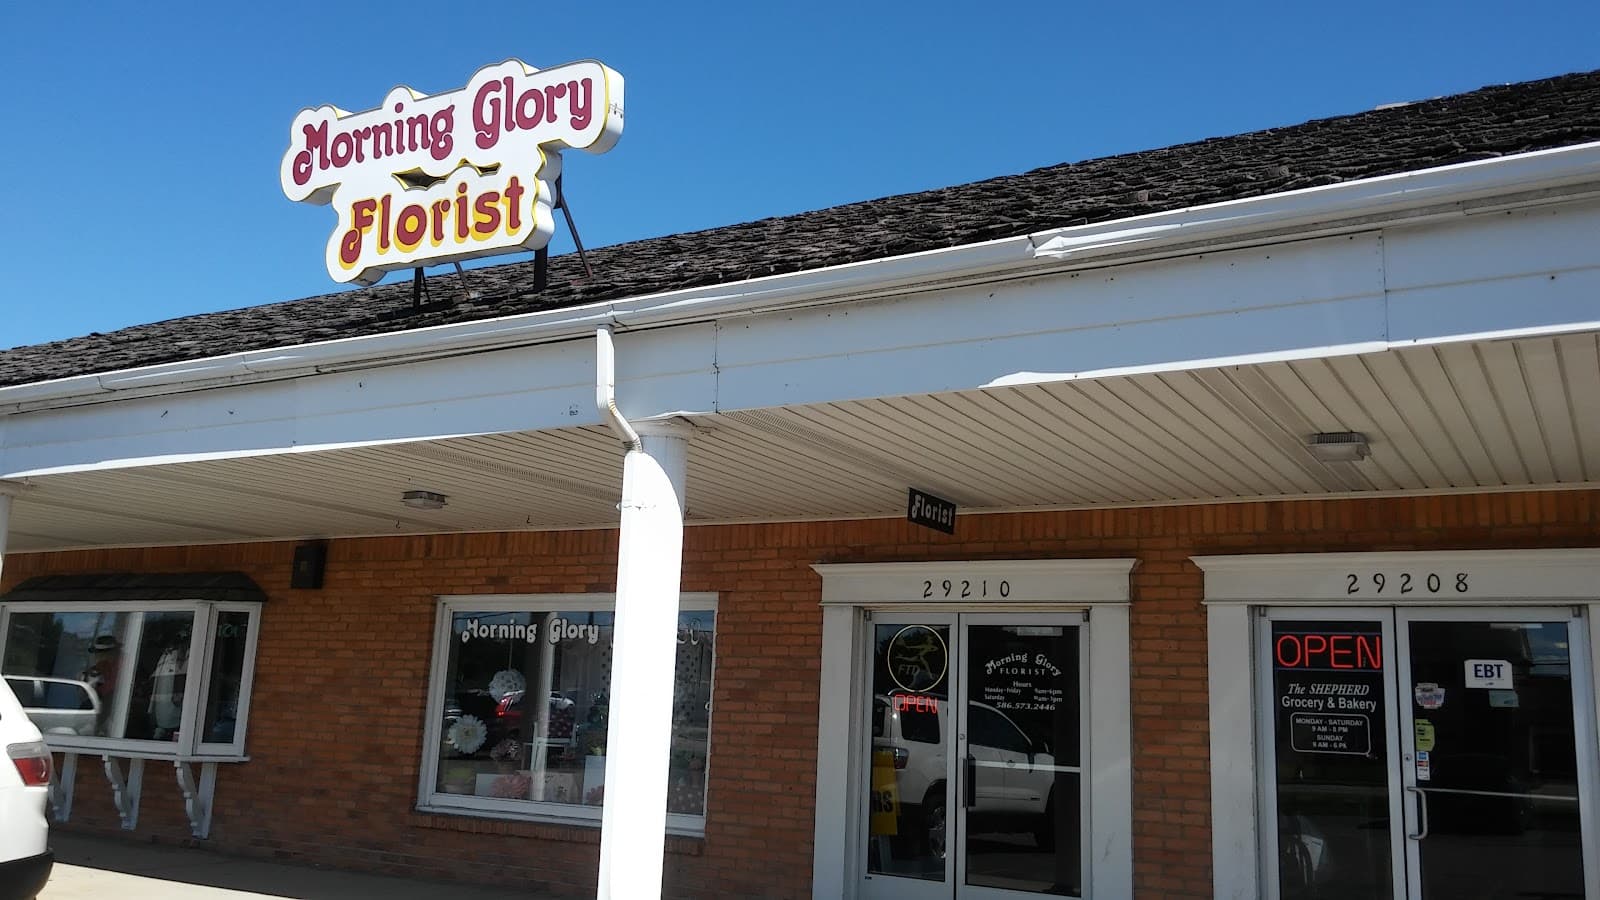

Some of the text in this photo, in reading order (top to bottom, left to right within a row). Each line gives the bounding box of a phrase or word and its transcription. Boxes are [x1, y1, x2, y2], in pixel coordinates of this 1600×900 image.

[293, 76, 592, 185] Morning Glory
[339, 176, 525, 268] Florist
[911, 494, 953, 526] Florist
[923, 580, 1010, 598] 29210
[1347, 573, 1468, 594] 29208
[461, 618, 599, 644] Morning Glory
[1277, 635, 1381, 669] OPEN
[898, 664, 920, 675] FTD
[985, 653, 1061, 676] Morning Glory
[1473, 663, 1504, 678] EBT
[1288, 684, 1369, 695] The SHEPHERD
[894, 694, 938, 714] OPEN
[996, 702, 1056, 710] 586.573.2446
[1282, 696, 1376, 712] Grocery & Bakery
